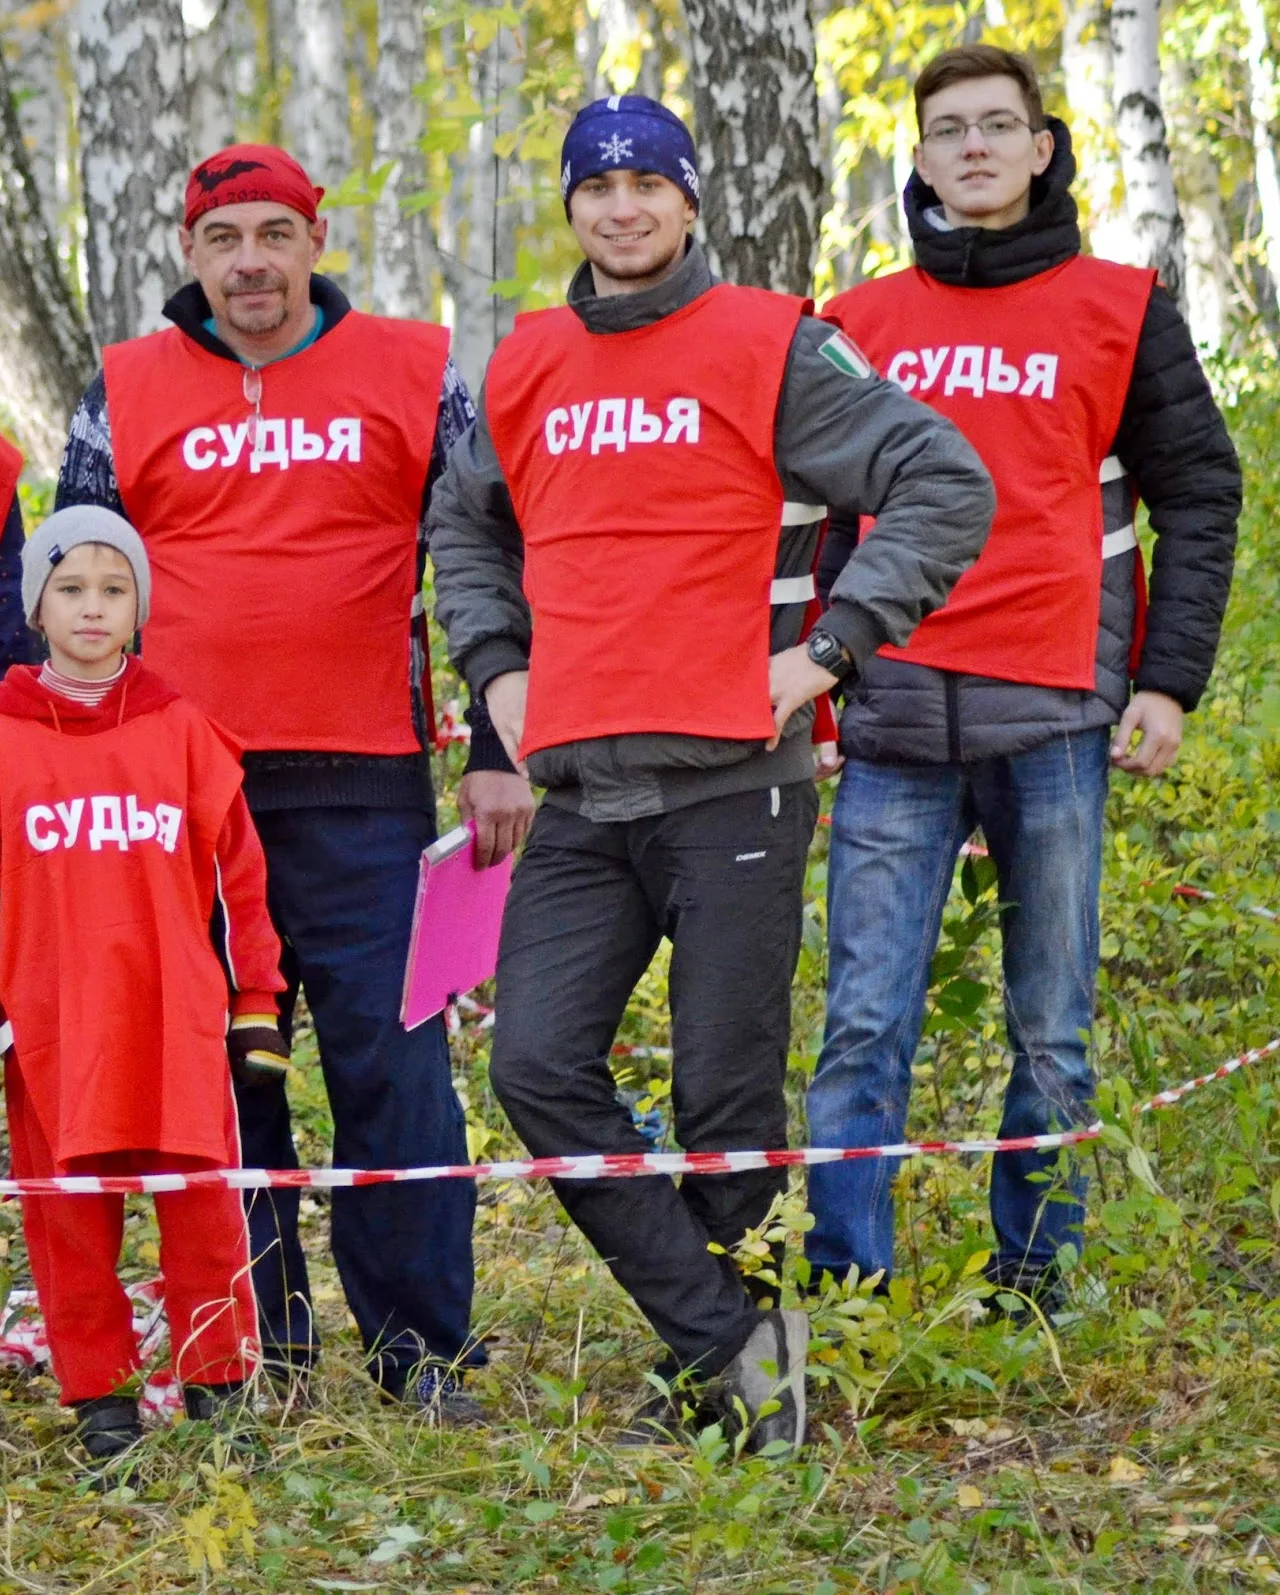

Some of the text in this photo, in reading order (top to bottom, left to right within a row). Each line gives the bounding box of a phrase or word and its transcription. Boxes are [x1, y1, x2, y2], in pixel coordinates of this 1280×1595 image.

[887, 345, 1058, 399] СУДЬЯ
[182, 417, 361, 473] СУДЬЯ
[545, 397, 700, 455] СУДЬЯ
[25, 794, 183, 853] СУДЬЯ
